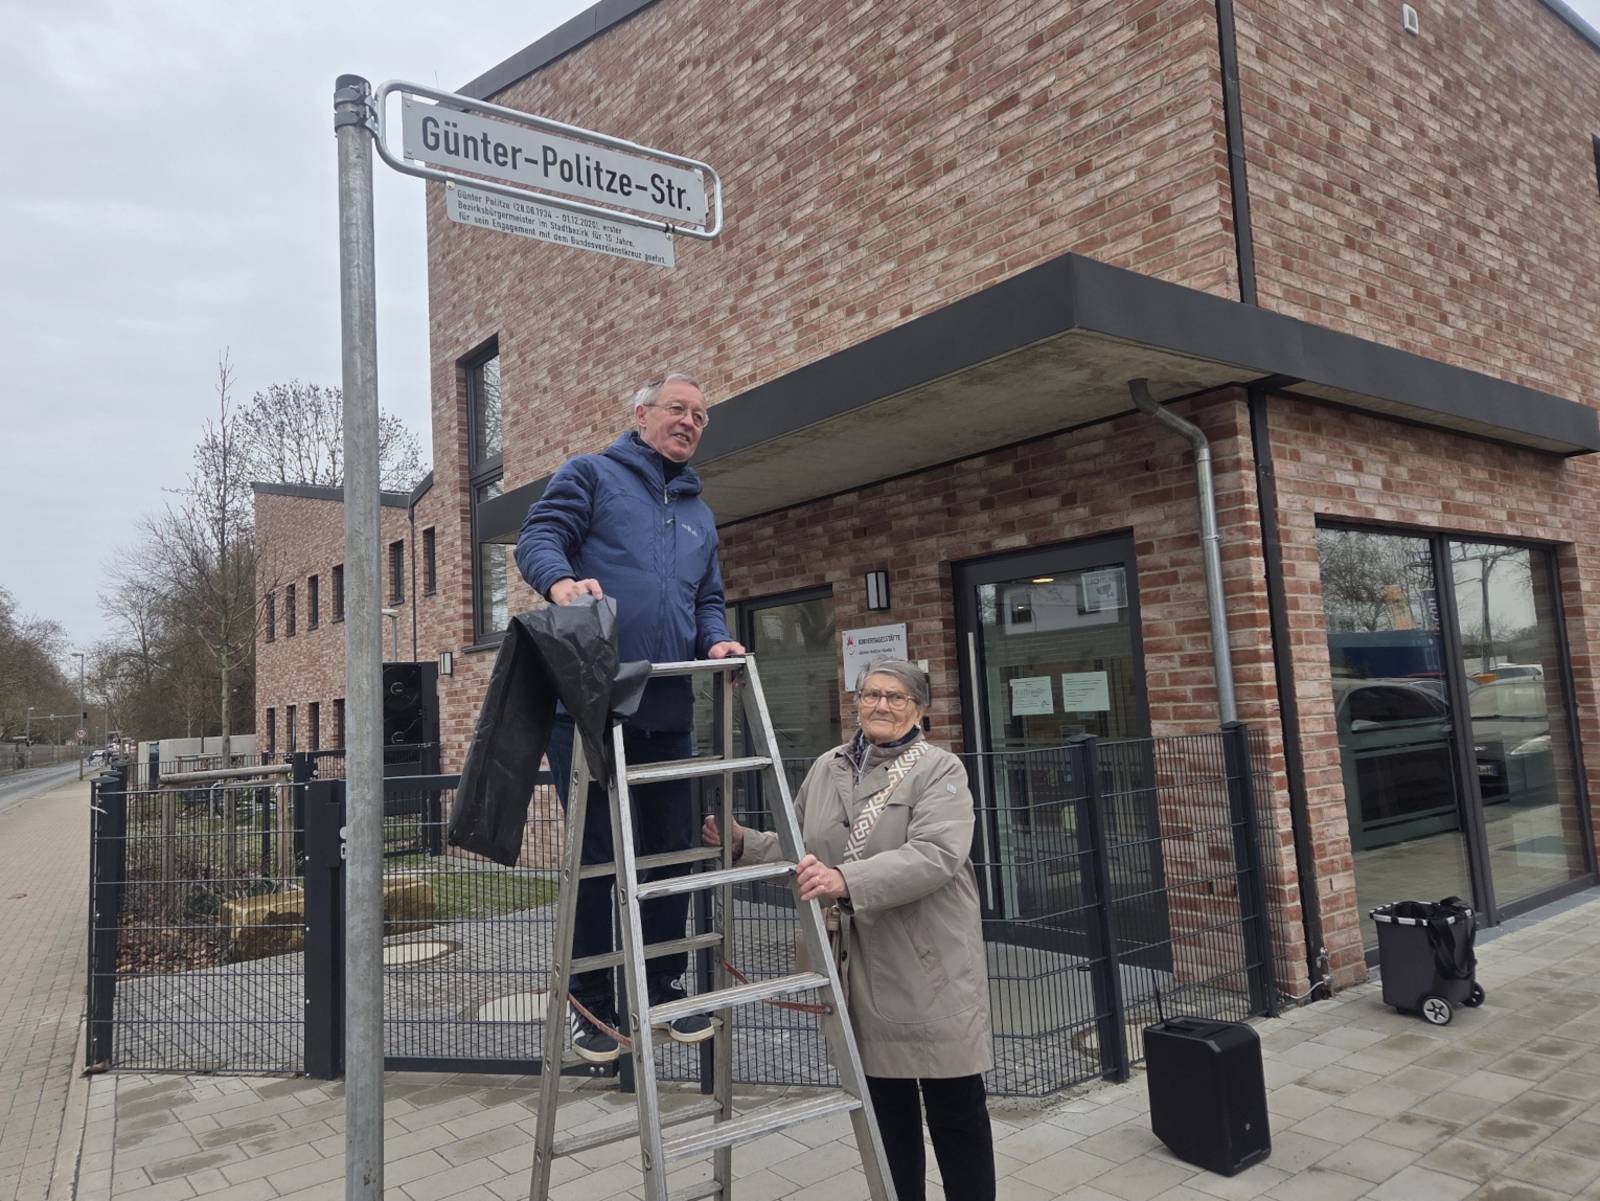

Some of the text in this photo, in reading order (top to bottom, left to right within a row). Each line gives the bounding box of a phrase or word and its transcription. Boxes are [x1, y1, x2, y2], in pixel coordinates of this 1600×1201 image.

[422, 116, 692, 212] Günter-Politze-Str.
[457, 189, 482, 202] Günter
[486, 195, 510, 209] Politze
[603, 225, 622, 235] erster
[457, 200, 536, 225] Bezirksbürgermeister
[539, 218, 548, 228] im
[550, 221, 589, 238] Stadtbezirk
[592, 231, 602, 241] für
[604, 233, 613, 242] 15
[458, 211, 471, 221] für
[474, 216, 490, 226] sein
[492, 218, 536, 236] Engagement
[539, 231, 551, 240] mit
[553, 233, 569, 243] dem
[570, 236, 642, 258] Bundesverdienstkreuz
